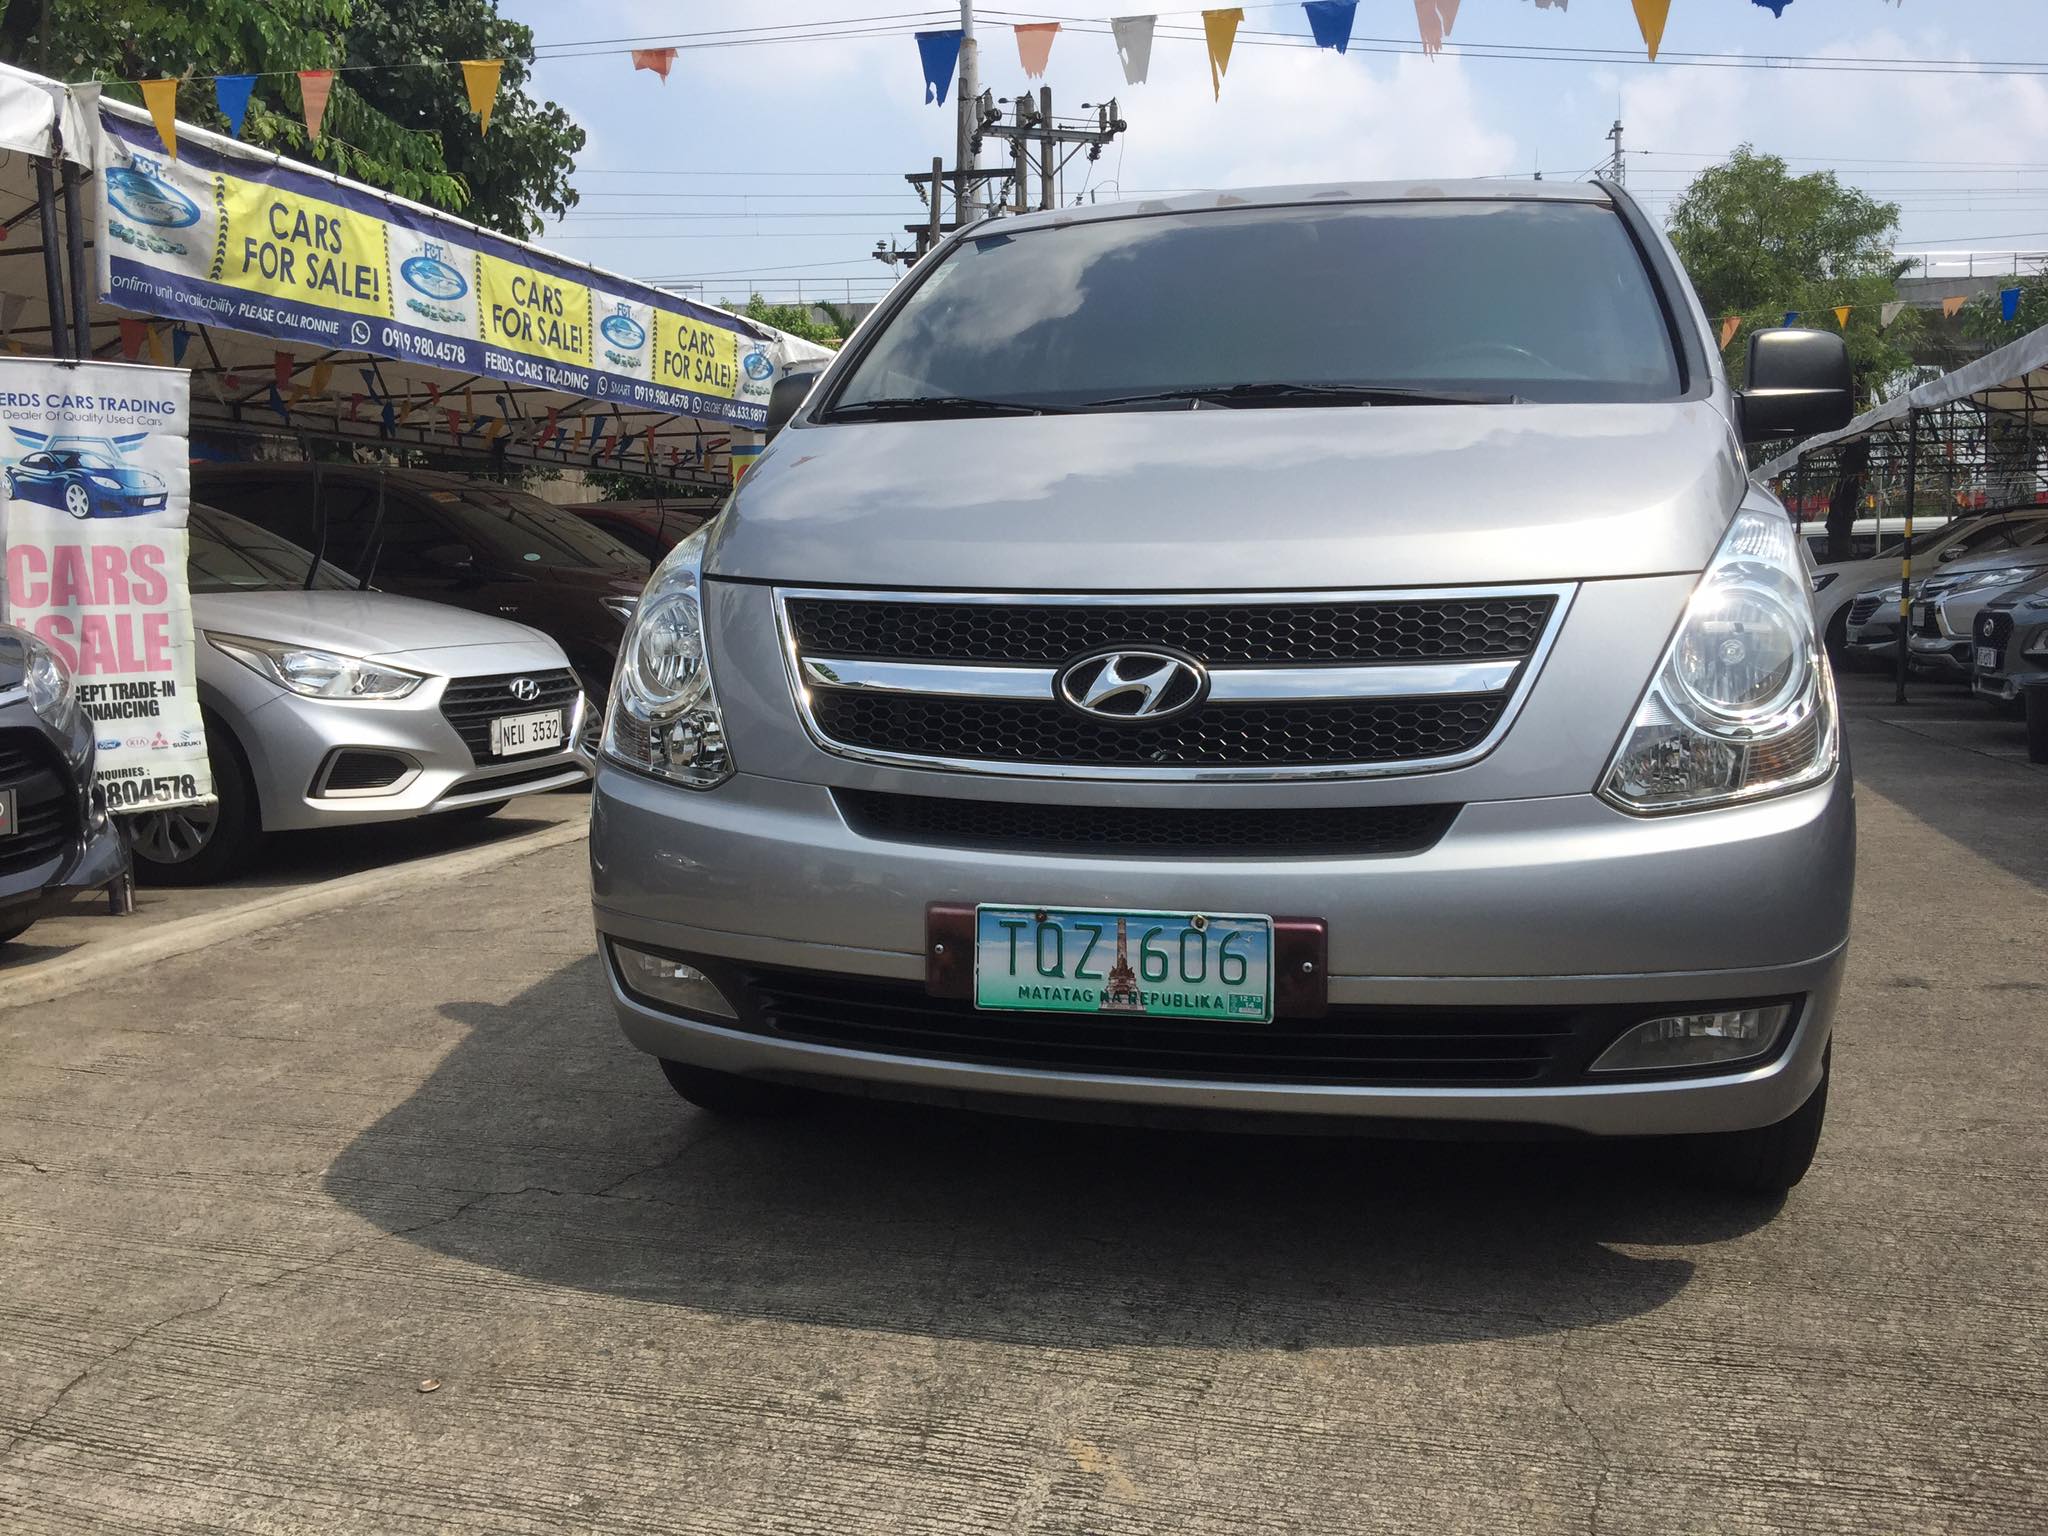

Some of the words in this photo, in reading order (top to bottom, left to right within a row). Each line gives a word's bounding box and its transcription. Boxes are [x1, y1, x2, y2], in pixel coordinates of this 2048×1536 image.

[269, 202, 342, 254] CARS
[242, 237, 296, 284] FOR
[306, 253, 380, 301] SALE!
[110, 275, 153, 295] onfirm
[155, 286, 173, 300] unit
[175, 292, 236, 316] availability
[238, 303, 274, 322] PLEASE
[276, 311, 300, 328] CALL
[300, 315, 339, 335] RONNIE
[512, 276, 563, 316] CARS
[382, 327, 466, 364] 0919.980.4578
[492, 305, 532, 341] FOR
[538, 317, 582, 354] SALE!
[678, 325, 714, 358] CARS
[485, 352, 514, 375] FERDS
[516, 360, 543, 381] CARS
[545, 367, 589, 390] TRADING
[610, 381, 631, 396] SMART
[634, 385, 689, 410] 0919.980.4578
[664, 351, 690, 380] FOR
[695, 361, 731, 389] SALE!
[0, 392, 40, 408] ERDS
[46, 394, 94, 410] CARS
[99, 397, 176, 415] TRADING
[3, 410, 42, 420] Dealer
[45, 410, 60, 421] Of
[63, 411, 103, 425] Quality
[106, 413, 134, 425] Used
[136, 415, 162, 426] Cars
[7, 544, 168, 608] CARS
[34, 612, 173, 677] SALE
[110, 680, 176, 701] TRADE-IN
[172, 740, 202, 749] SUZUKI
[503, 724, 525, 747] NEU
[532, 719, 559, 742] 3532
[999, 920, 1104, 979] TQZ
[1140, 926, 1248, 986] 606
[1018, 986, 1094, 1002] MATATAG
[1100, 991, 1122, 1004] NA
[1128, 991, 1225, 1009] REPUBLIKA
